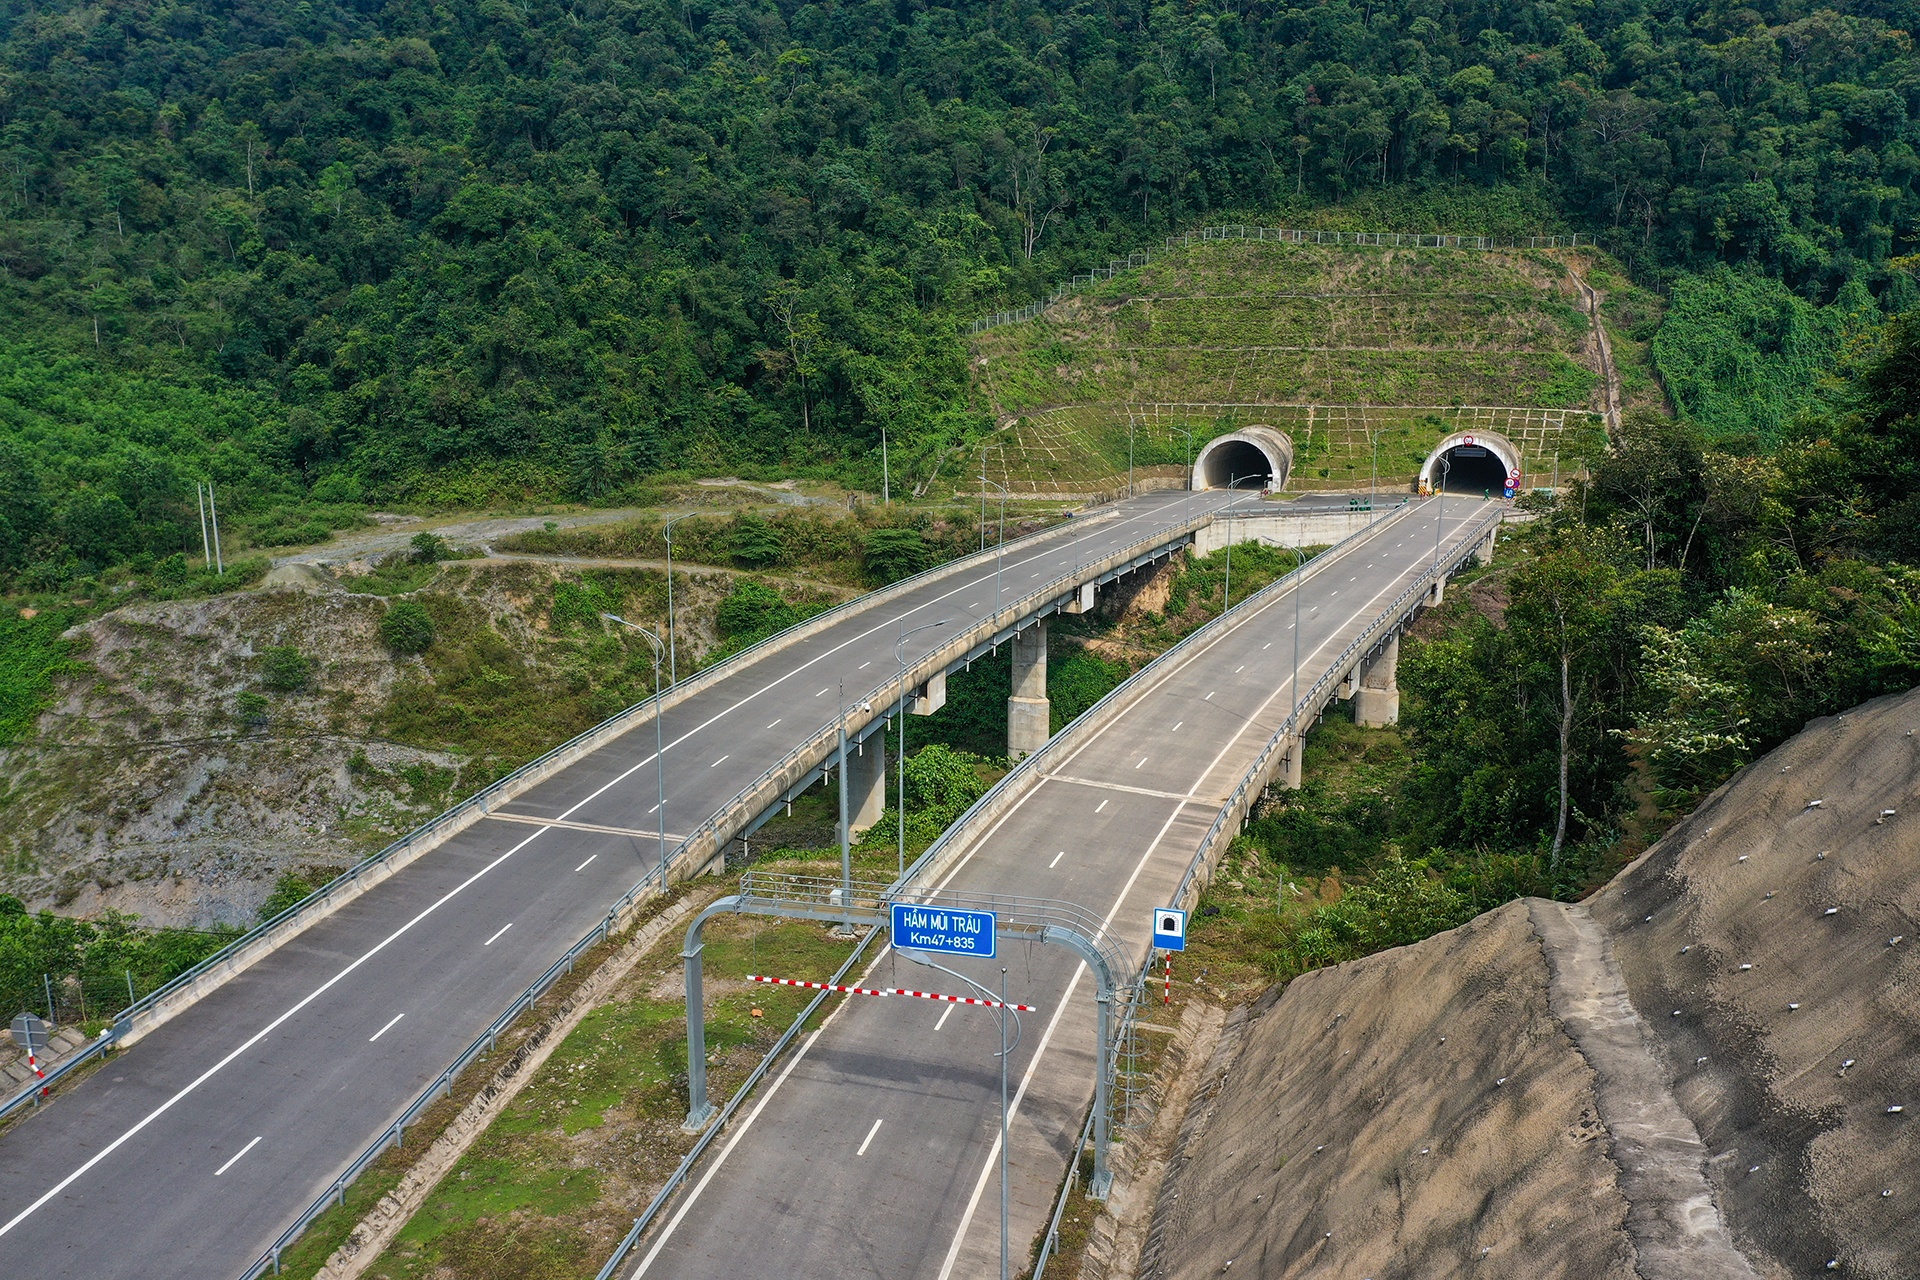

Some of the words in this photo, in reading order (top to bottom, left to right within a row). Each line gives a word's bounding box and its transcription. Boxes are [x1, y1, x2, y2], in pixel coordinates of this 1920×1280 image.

[904, 908, 927, 929] HẦM
[931, 912, 948, 931] MŨI
[952, 915, 981, 934] TRÂU
[911, 932, 975, 949] Km47+835
